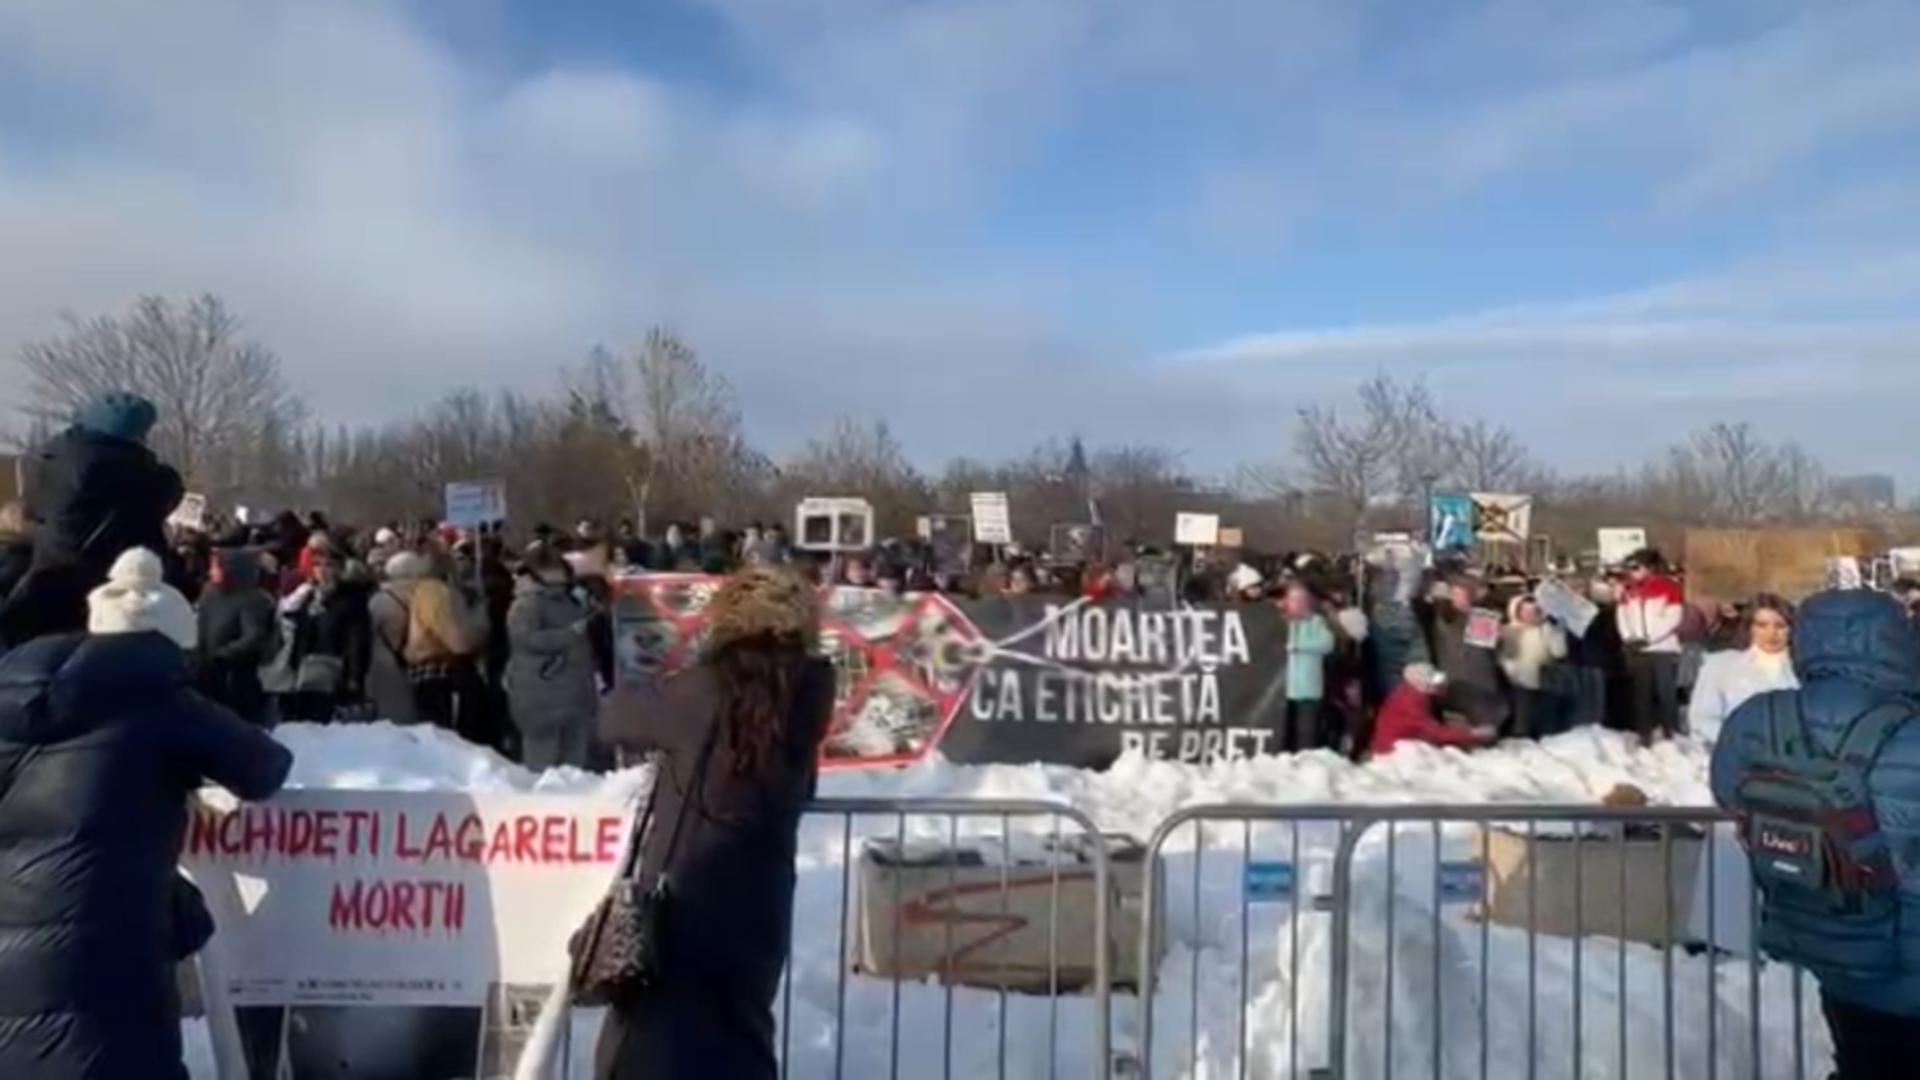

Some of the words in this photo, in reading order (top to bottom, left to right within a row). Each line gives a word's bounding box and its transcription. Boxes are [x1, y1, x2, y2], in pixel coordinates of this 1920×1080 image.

[1044, 605, 1249, 664] MOARTEA
[971, 668, 1023, 721] CA
[180, 808, 380, 860] NCHIDETI
[396, 811, 621, 864] LAGARELE
